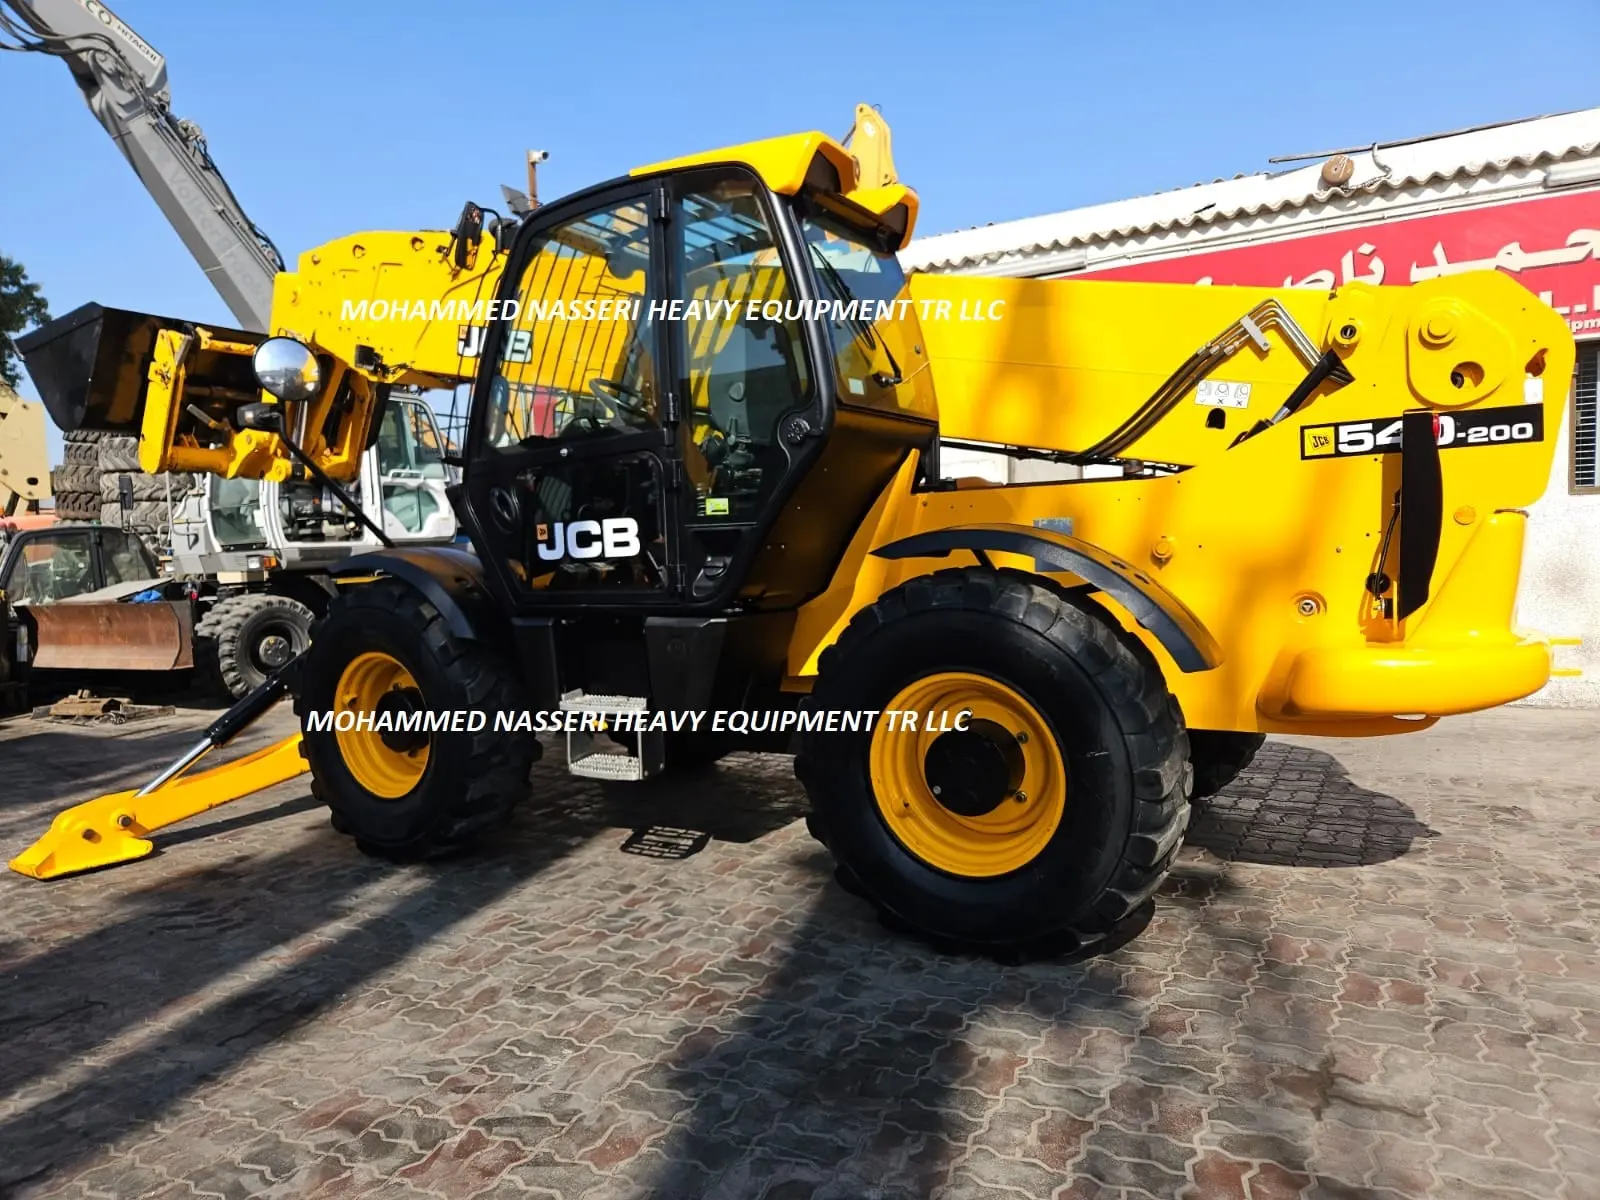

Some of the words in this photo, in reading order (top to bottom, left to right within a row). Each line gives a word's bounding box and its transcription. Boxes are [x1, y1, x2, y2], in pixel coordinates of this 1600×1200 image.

[116, 25, 158, 61] HITACHI
[1410, 228, 1600, 283] حمد
[1312, 435, 1330, 449] JCB
[536, 517, 641, 561] JCB
